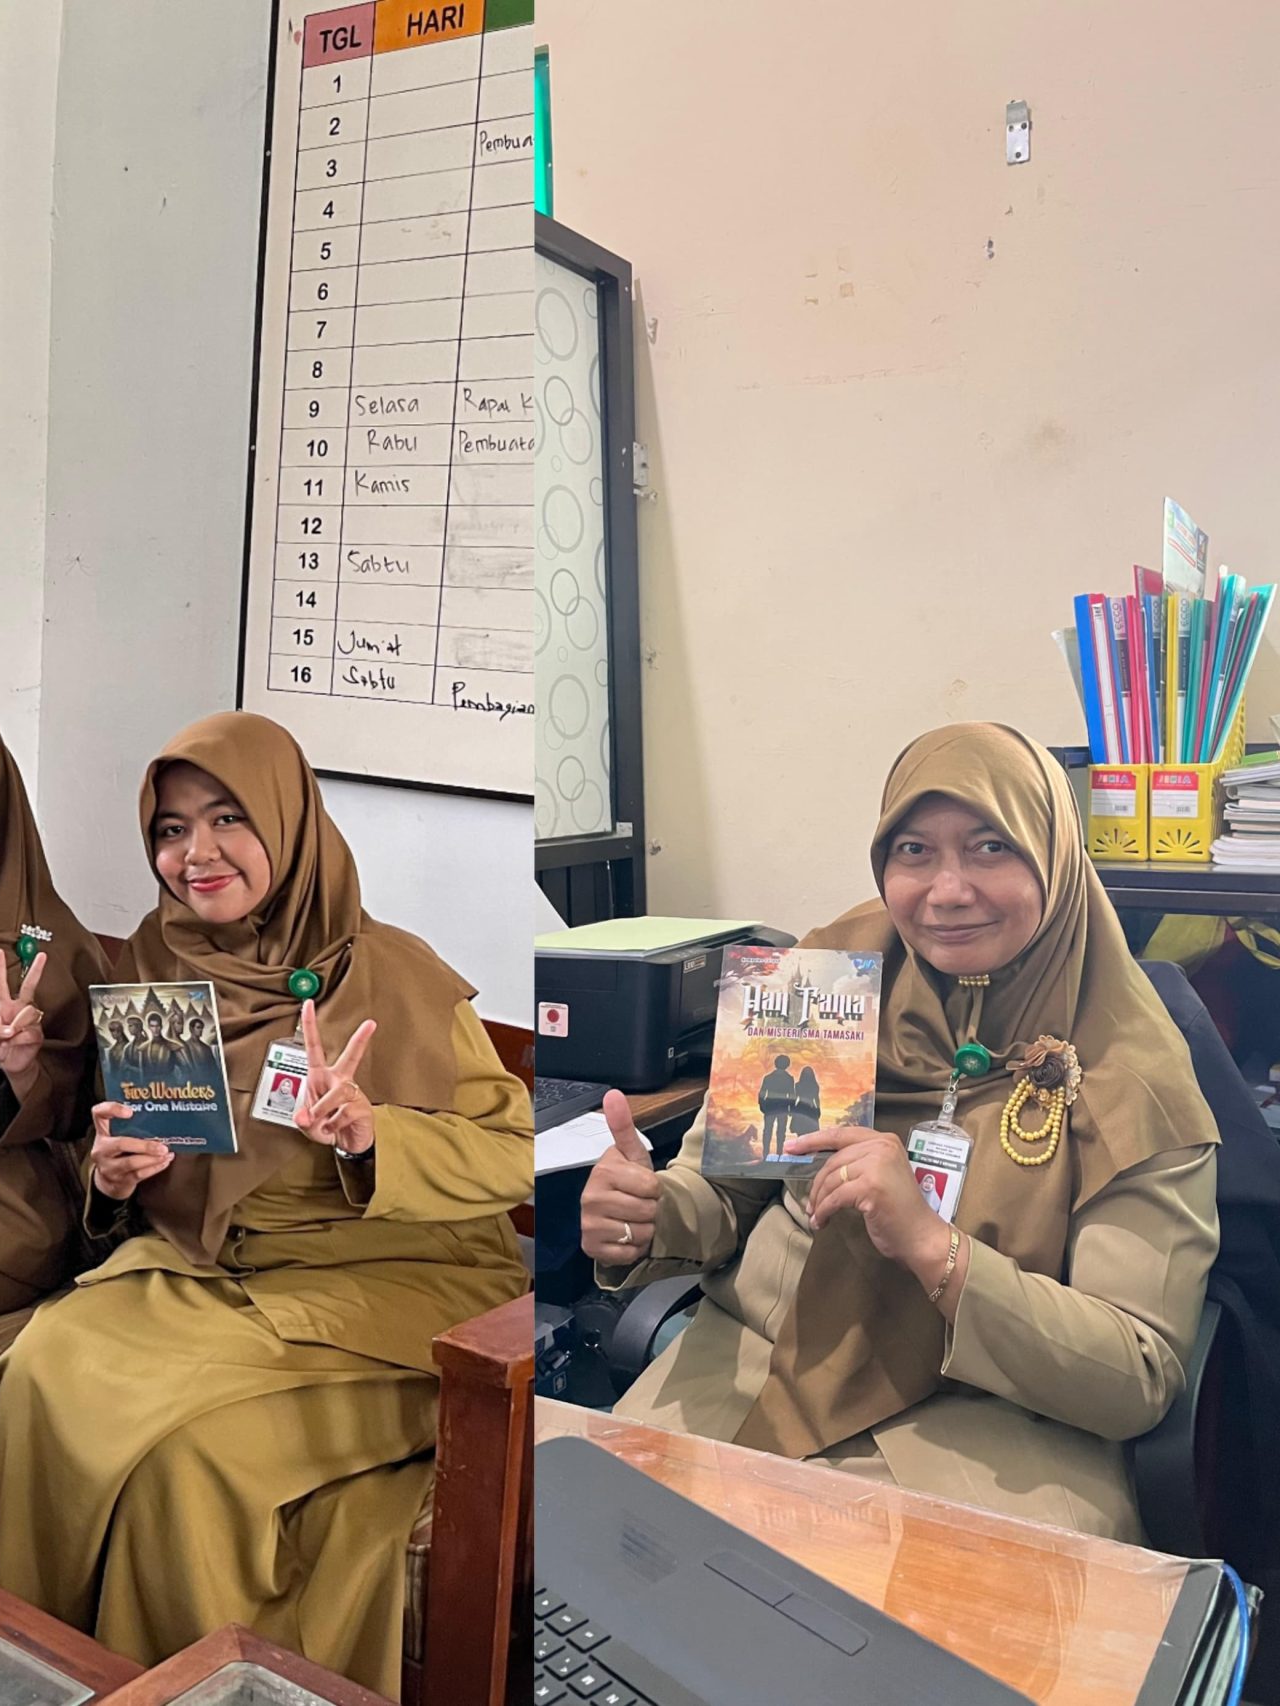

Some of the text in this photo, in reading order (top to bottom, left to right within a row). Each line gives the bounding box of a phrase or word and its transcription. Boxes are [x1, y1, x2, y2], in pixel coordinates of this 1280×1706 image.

[320, 4, 464, 52] TGL HARI
[333, 75, 342, 93] 1
[329, 117, 340, 135] 2
[480, 130, 533, 156] Pembua
[326, 160, 337, 177] 3
[323, 201, 334, 218] 4
[320, 242, 331, 260] 5
[317, 283, 328, 300] 6
[316, 322, 327, 339] 7
[312, 361, 323, 378] 8
[309, 401, 320, 418] 9
[307, 440, 328, 457] 10
[368, 429, 418, 453] Rabu
[304, 479, 324, 496] 11
[355, 470, 411, 494] Kamis
[301, 517, 322, 535] 12
[298, 553, 320, 570] 13
[347, 550, 410, 574] Sabtu
[296, 591, 317, 608] 14
[293, 628, 314, 645] 15
[290, 666, 312, 683] 16
[748, 1027, 865, 1041] DAN MISTERI SMA TAMASAKI
[149, 1080, 216, 1100] Wonders
[144, 1101, 169, 1112] One
